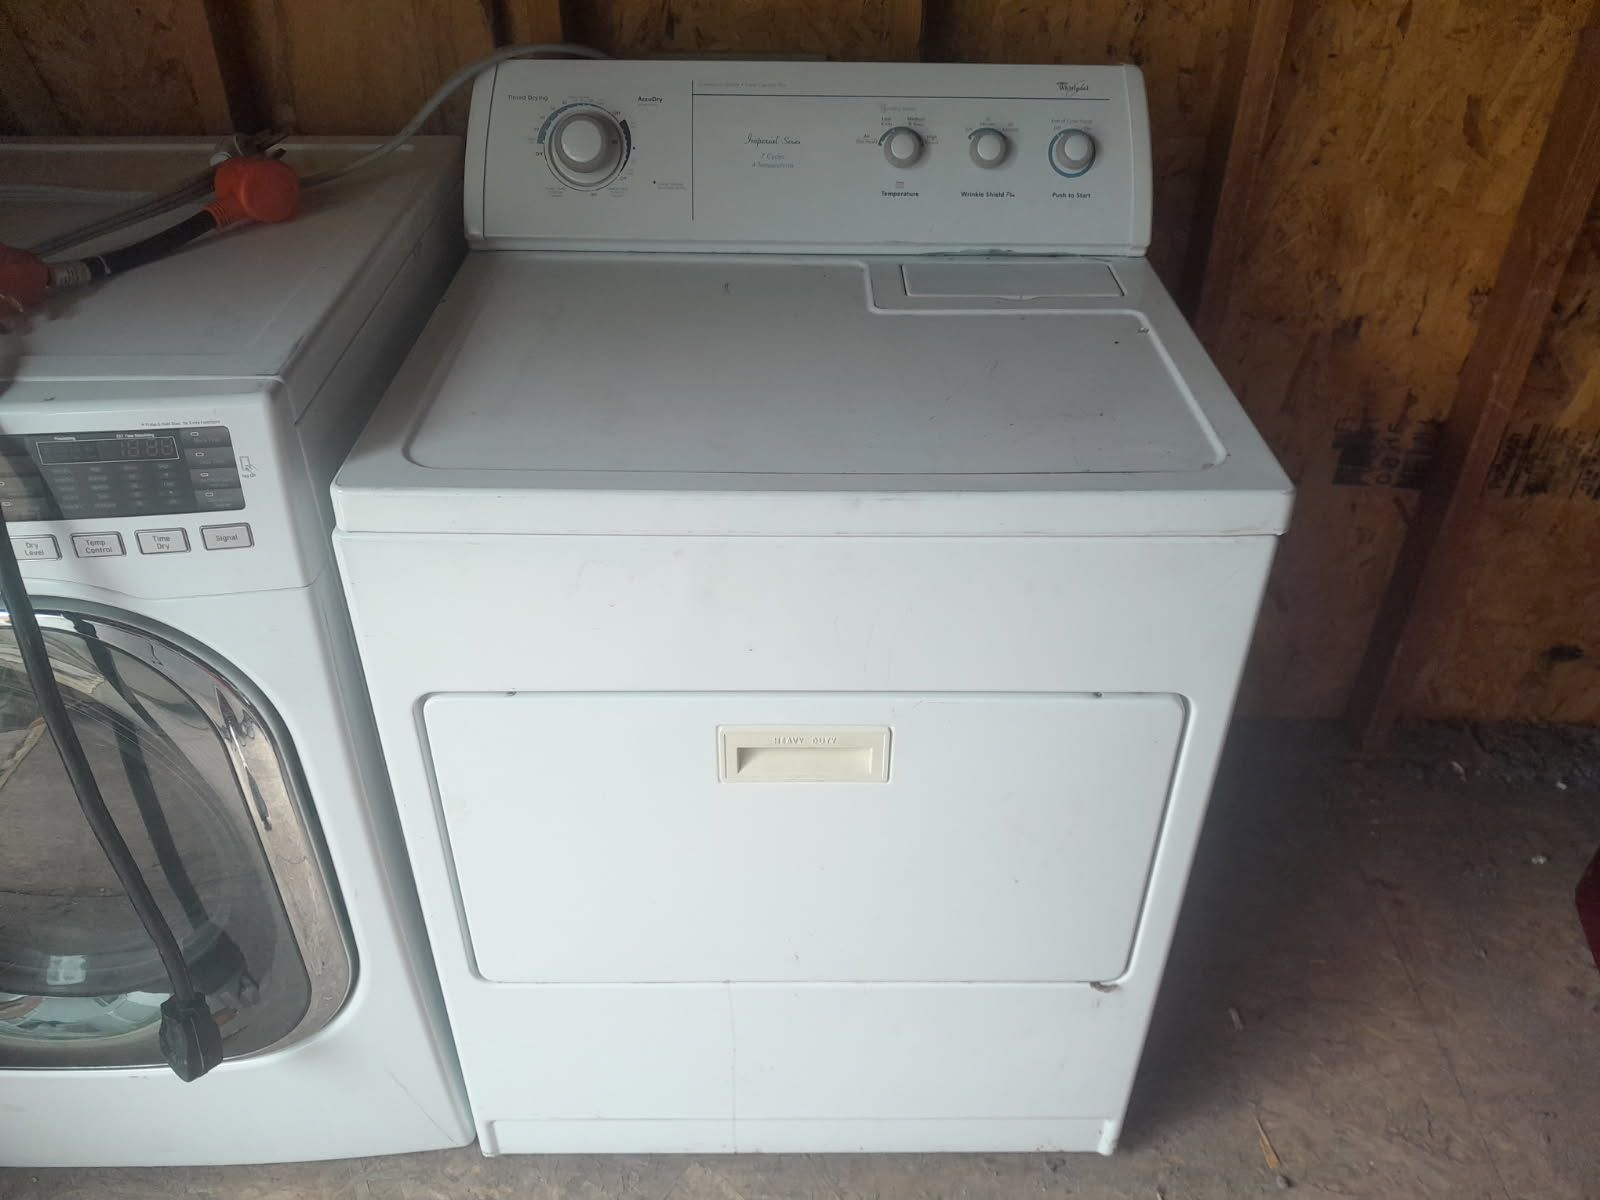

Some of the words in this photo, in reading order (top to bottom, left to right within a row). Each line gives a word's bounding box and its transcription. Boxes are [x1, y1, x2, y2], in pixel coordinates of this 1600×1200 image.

[527, 94, 549, 102] Drying
[637, 95, 663, 103] AccuDry
[747, 133, 779, 147] Imperial
[880, 190, 920, 198] Temperature
[215, 533, 239, 543] Signal
[25, 542, 39, 550] Dry
[85, 546, 113, 554] Control
[24, 549, 45, 557] Level
[774, 735, 805, 745] HEAVY
[812, 735, 838, 745] DUTY
